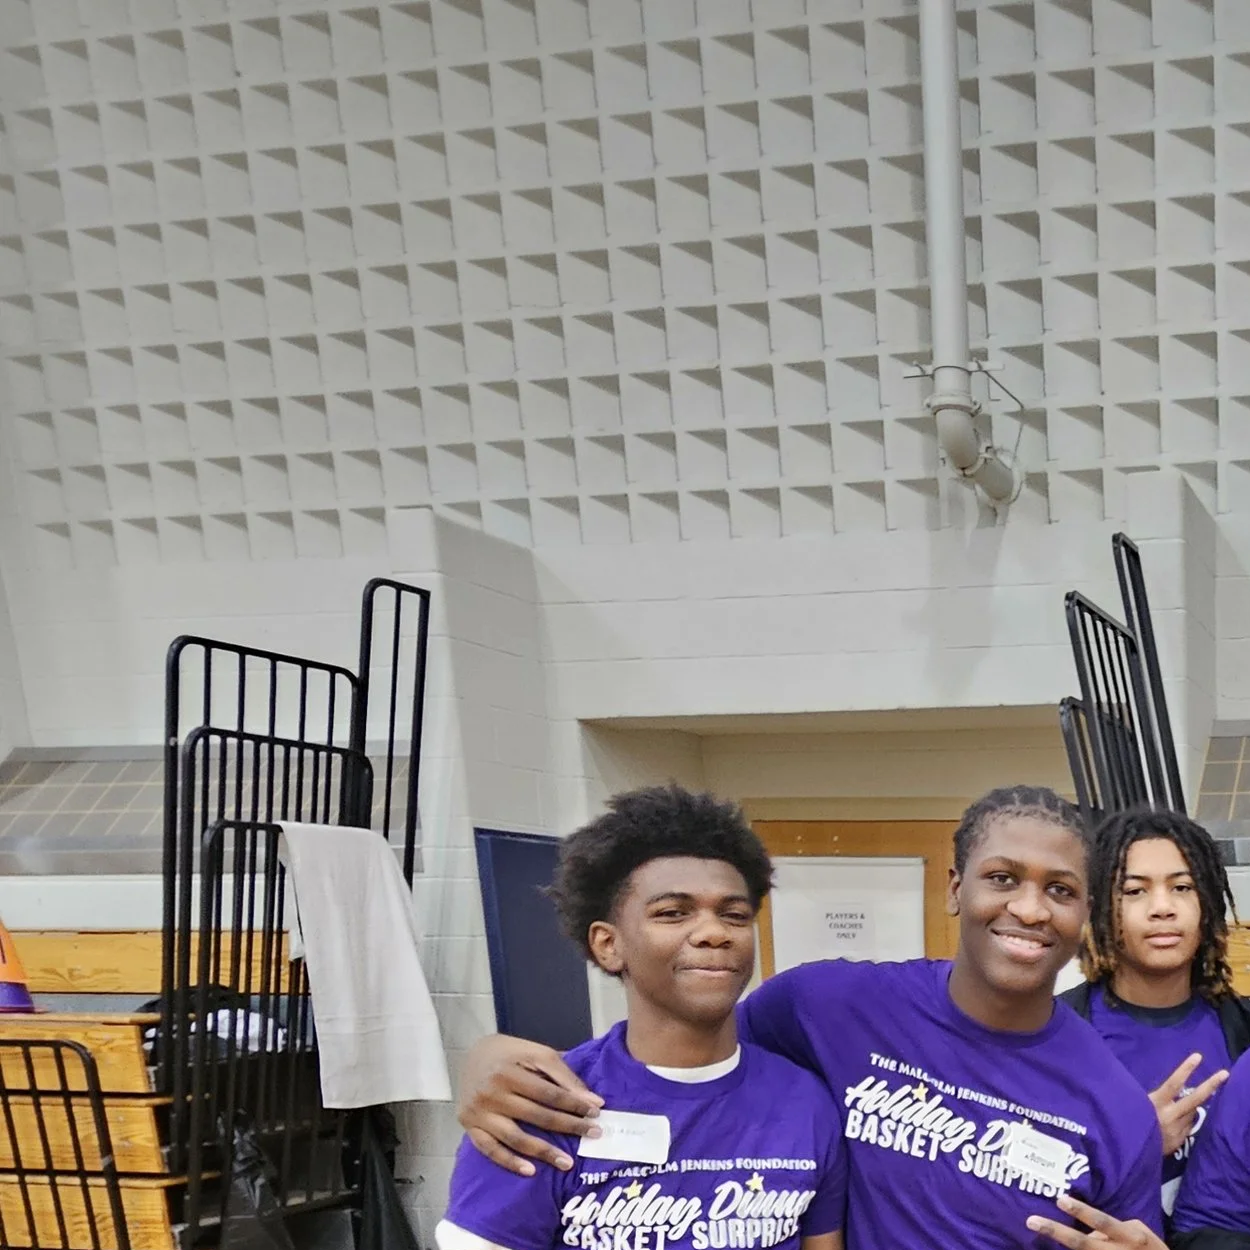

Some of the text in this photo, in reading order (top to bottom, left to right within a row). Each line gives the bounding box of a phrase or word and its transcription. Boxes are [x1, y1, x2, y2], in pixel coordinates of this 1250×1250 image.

[825, 912, 858, 921] PLAYERS
[828, 922, 863, 930] COACHES
[836, 932, 857, 940] ONLY
[844, 1075, 976, 1153] Holiday
[870, 1052, 897, 1072] THE
[956, 1086, 1008, 1111] JENKINS
[1008, 1102, 1087, 1136] FOUNDATION
[844, 1108, 945, 1162] BASKET
[580, 1171, 609, 1185] THE
[680, 1158, 734, 1173] JENKINS
[561, 1183, 702, 1241] Holiday
